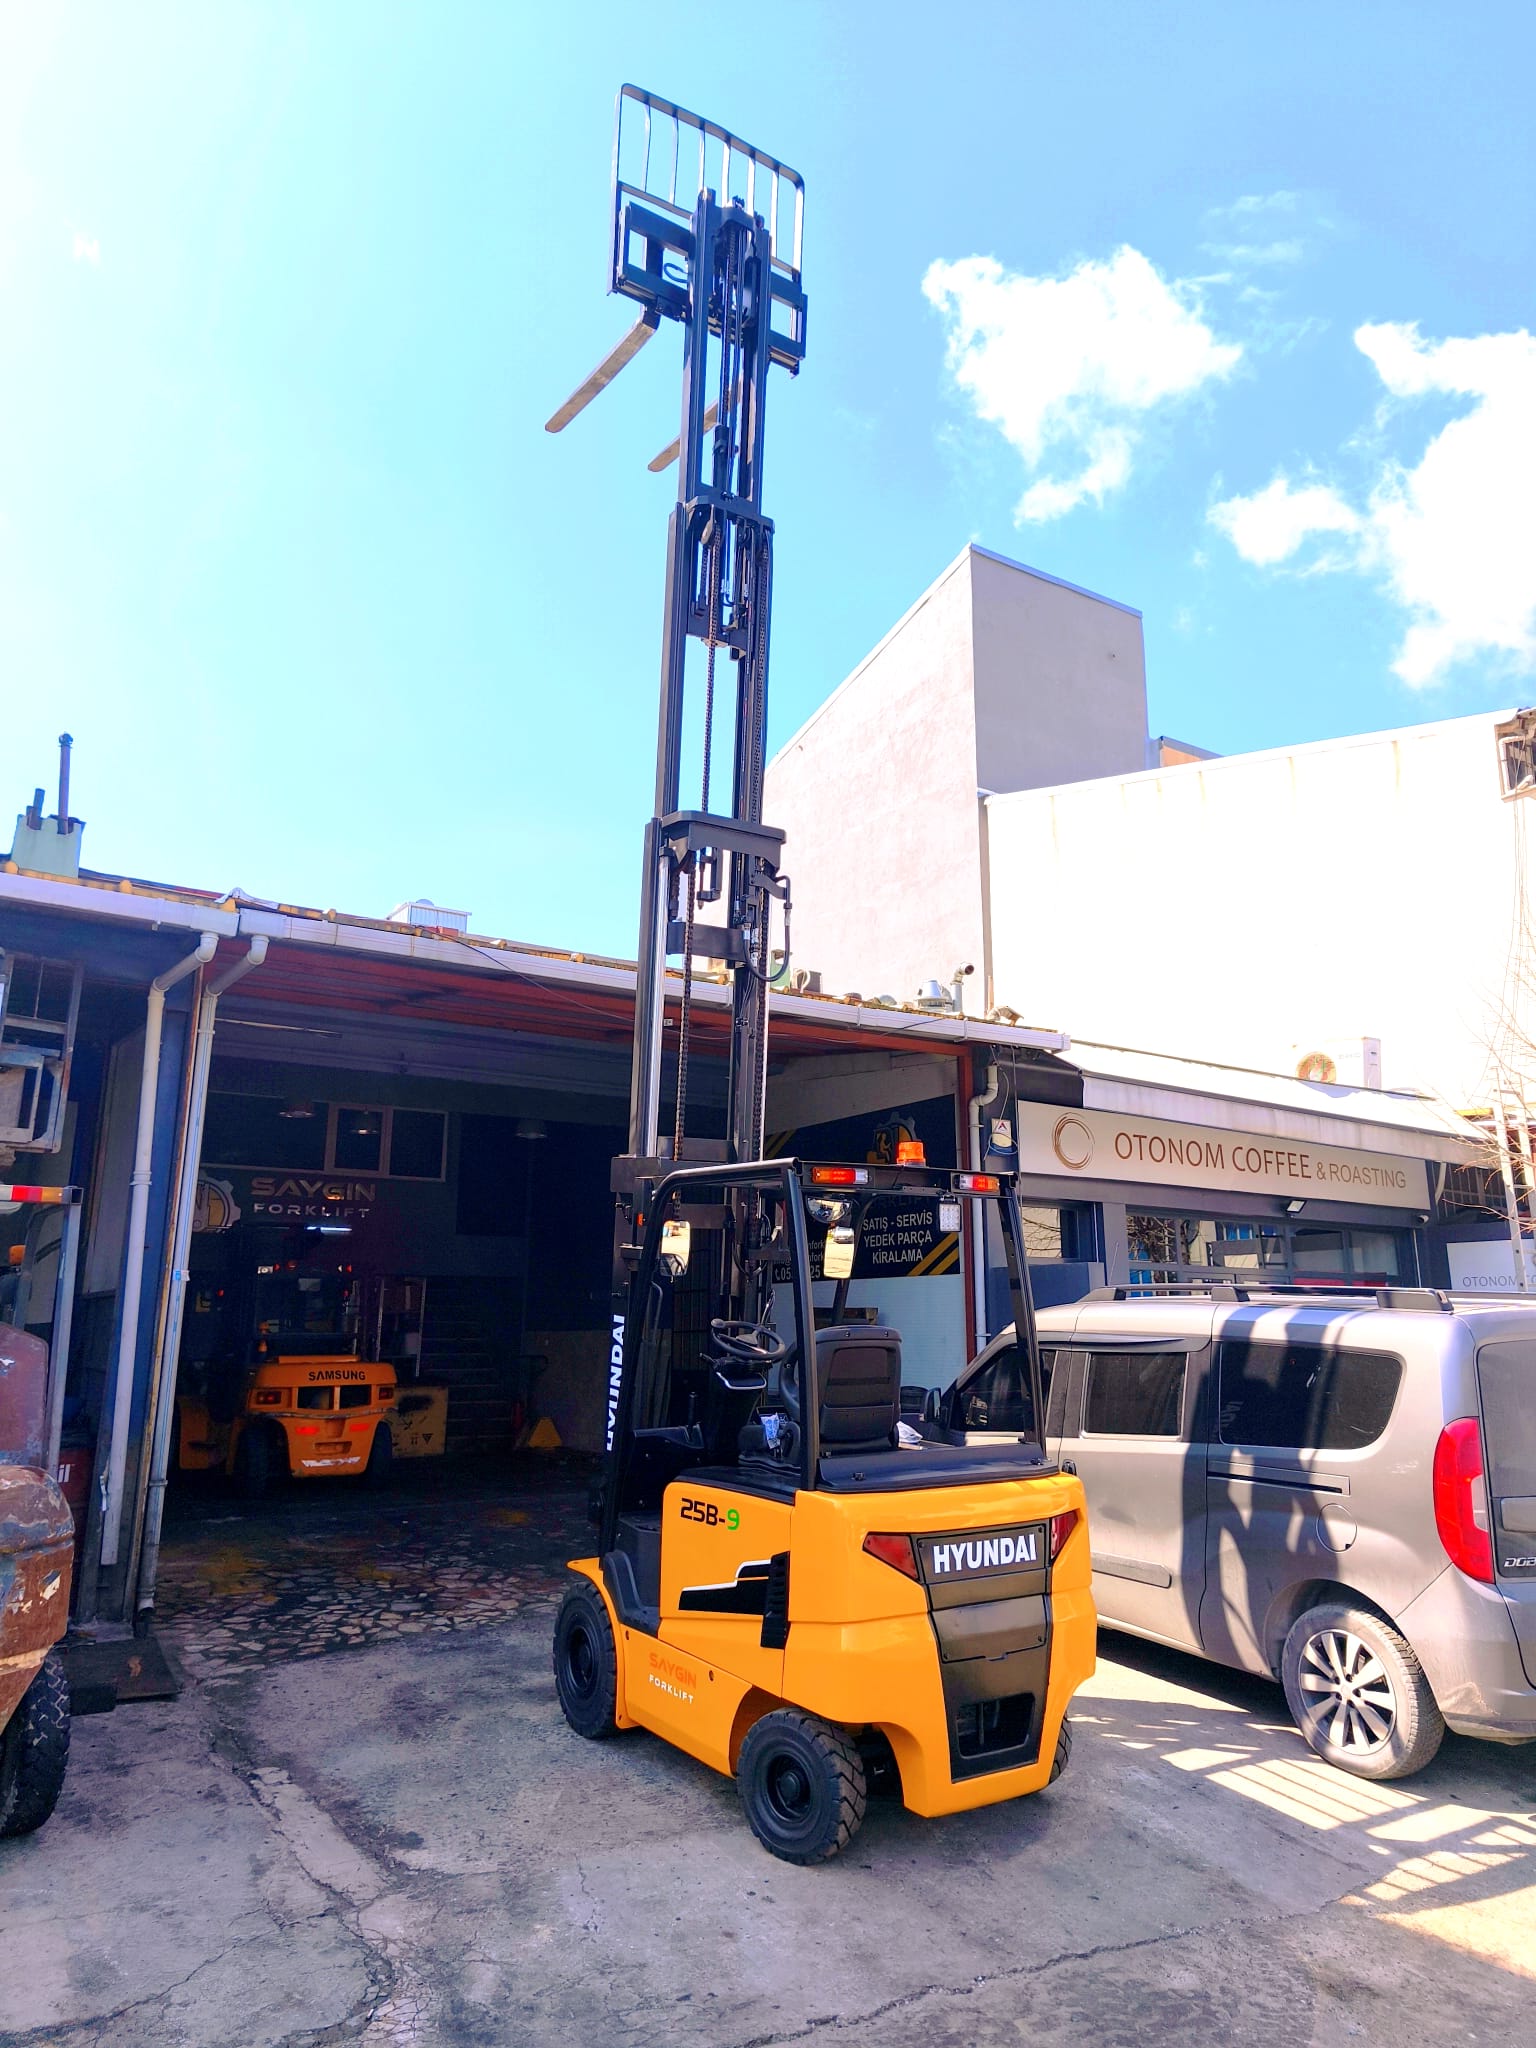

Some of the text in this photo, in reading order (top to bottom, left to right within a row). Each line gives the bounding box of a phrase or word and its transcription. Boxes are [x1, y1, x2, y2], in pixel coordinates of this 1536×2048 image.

[1114, 1131, 1407, 1188] OTONOM COFFEE & ROASTING
[251, 1177, 376, 1202] SAYGIN
[253, 1202, 370, 1218] FORKLIFT
[863, 1216, 888, 1232] SATIŞ
[896, 1210, 933, 1227] SERVİS
[864, 1230, 932, 1248] YEDEK PARÇA
[872, 1250, 924, 1265] KİRALAMA
[308, 1369, 366, 1381] SAMSUNG
[680, 1497, 740, 1531] 25B-9
[933, 1533, 1037, 1574] HYUNDAI
[649, 1652, 697, 1689] SAYGIN
[649, 1673, 694, 1705] FORKLIFT
